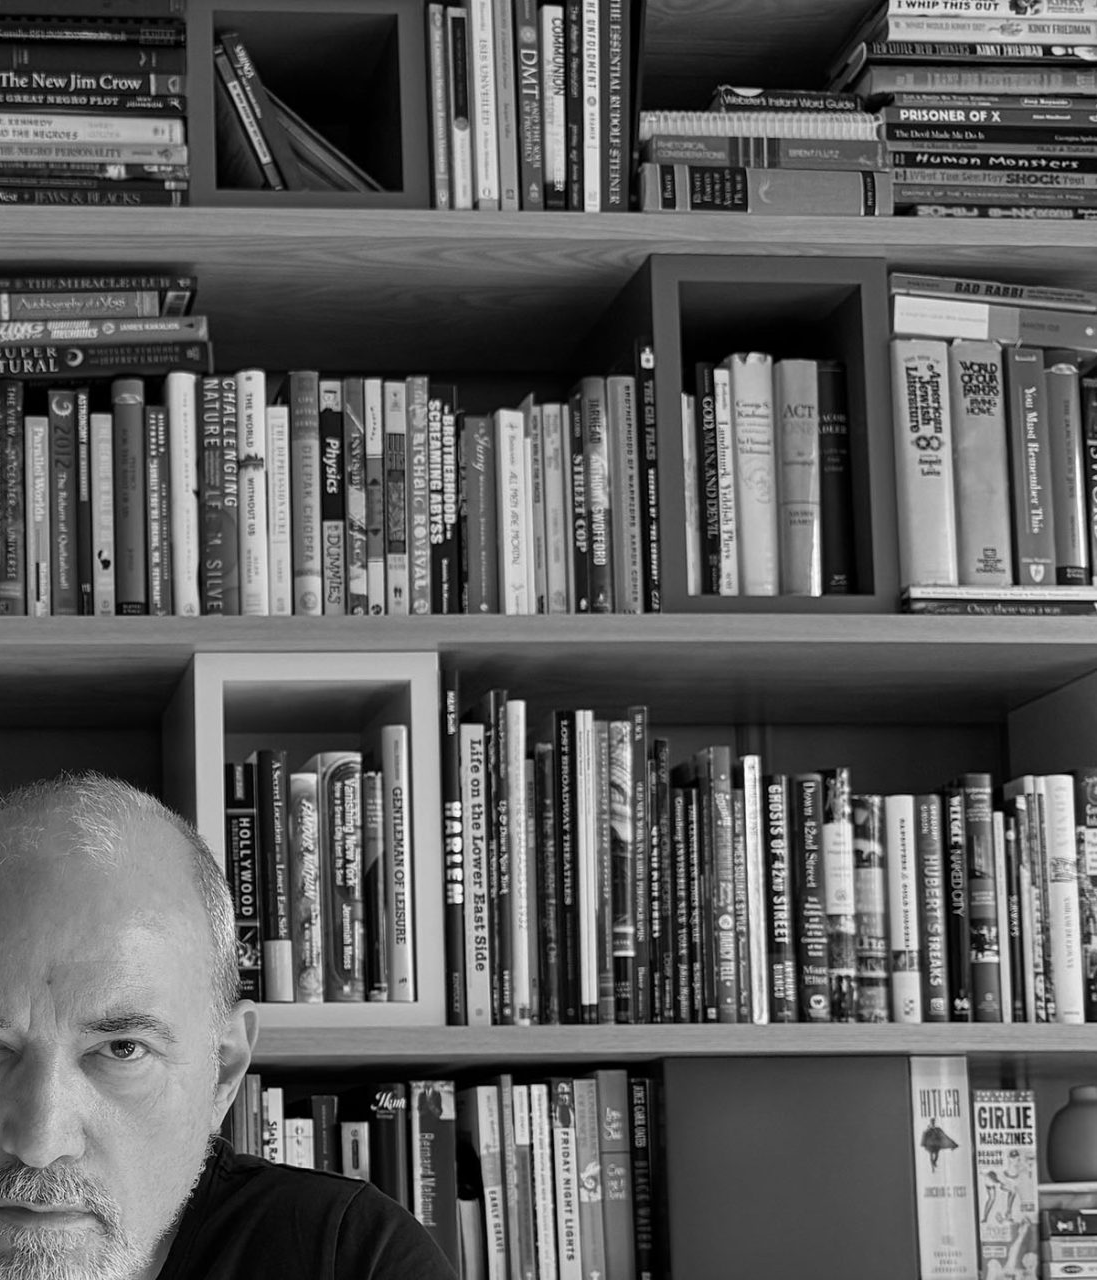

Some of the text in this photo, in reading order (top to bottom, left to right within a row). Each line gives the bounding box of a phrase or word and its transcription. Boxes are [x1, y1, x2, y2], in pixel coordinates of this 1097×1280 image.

[905, 1, 941, 10] WHIP
[943, 2, 972, 10] THIS
[975, 2, 1001, 11] OUT
[32, 74, 68, 89] New
[69, 74, 97, 92] Jim
[99, 75, 143, 91] Crow
[520, 49, 539, 99] DMT
[551, 18, 565, 97] COMMUNION
[899, 109, 1002, 122] PRISONER OF X
[915, 153, 1080, 169] Human Monsters
[954, 281, 1024, 299] BAD RABBI
[203, 379, 219, 448] NATURE
[906, 366, 920, 434] Literature
[920, 374, 932, 426] Jewish
[223, 379, 239, 507] CHALLENGING
[323, 438, 340, 495] Physics
[428, 399, 444, 545] SCREAMING ABYSS
[443, 414, 457, 524] BROTHERHOOD
[572, 453, 588, 553] STREET COP
[324, 534, 342, 605] DUMMIES
[238, 817, 254, 917] HOLLYWOOD
[340, 779, 358, 888] Vanishing New York
[391, 786, 406, 945] GENTLEMAN OF LEISURE
[444, 800, 464, 905] HARLEM
[469, 738, 489, 972] Life on the Lower East Side
[768, 784, 790, 944] GHOSTS OF 42ND STREET
[923, 853, 945, 987] HUBERT'S FREAKS
[919, 1089, 961, 1118] HITLER
[977, 1106, 1033, 1130] GIRLIE
[978, 1131, 1034, 1146] MAGAZINES
[419, 1131, 438, 1228] Bernard Malamud
[560, 1130, 576, 1262] FRIDAY NIGHT LIGHTS
[487, 1189, 505, 1255] EARLY GRAVE
